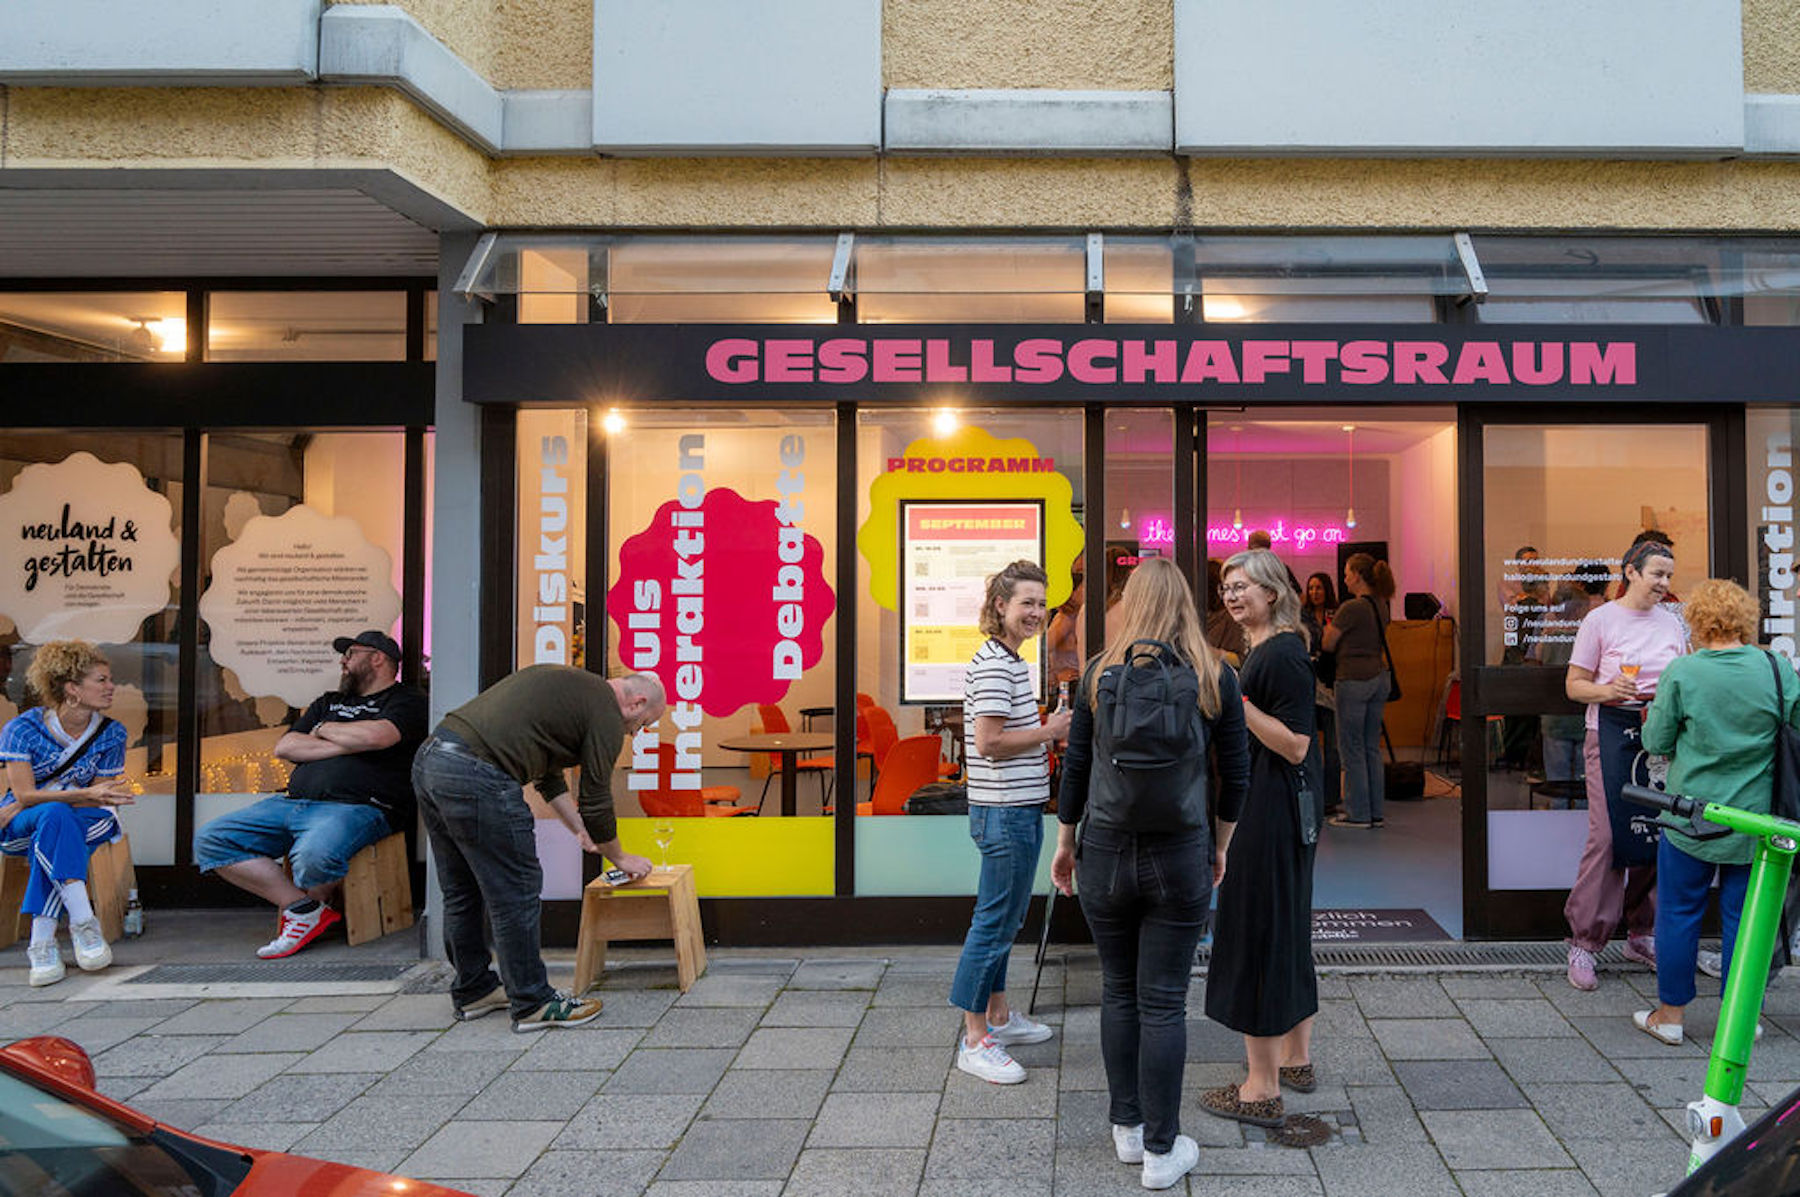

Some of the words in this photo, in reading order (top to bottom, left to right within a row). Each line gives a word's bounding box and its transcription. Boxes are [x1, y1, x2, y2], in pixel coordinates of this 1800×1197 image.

[706, 339, 1636, 385] GESELLSCHAFTSRAUM
[887, 457, 1056, 473] PROGRAMM
[22, 503, 115, 541] neuland
[120, 520, 138, 542] &
[919, 518, 1026, 530] SEPTEMBER
[533, 435, 569, 665] Diskurs
[1207, 527, 1240, 543] mes
[1293, 528, 1316, 549] go
[1322, 528, 1346, 542] on
[24, 540, 133, 592] gestalten
[773, 434, 805, 681] Debatte
[671, 433, 705, 791] Interaktion
[1504, 603, 1530, 614] Folge
[1531, 604, 1548, 613] uns
[1550, 603, 1566, 613] auf
[1523, 618, 1581, 629] /neulandund
[1523, 634, 1577, 644] /neulandun
[627, 579, 662, 791] Imuls
[1311, 911, 1378, 921] zlich
